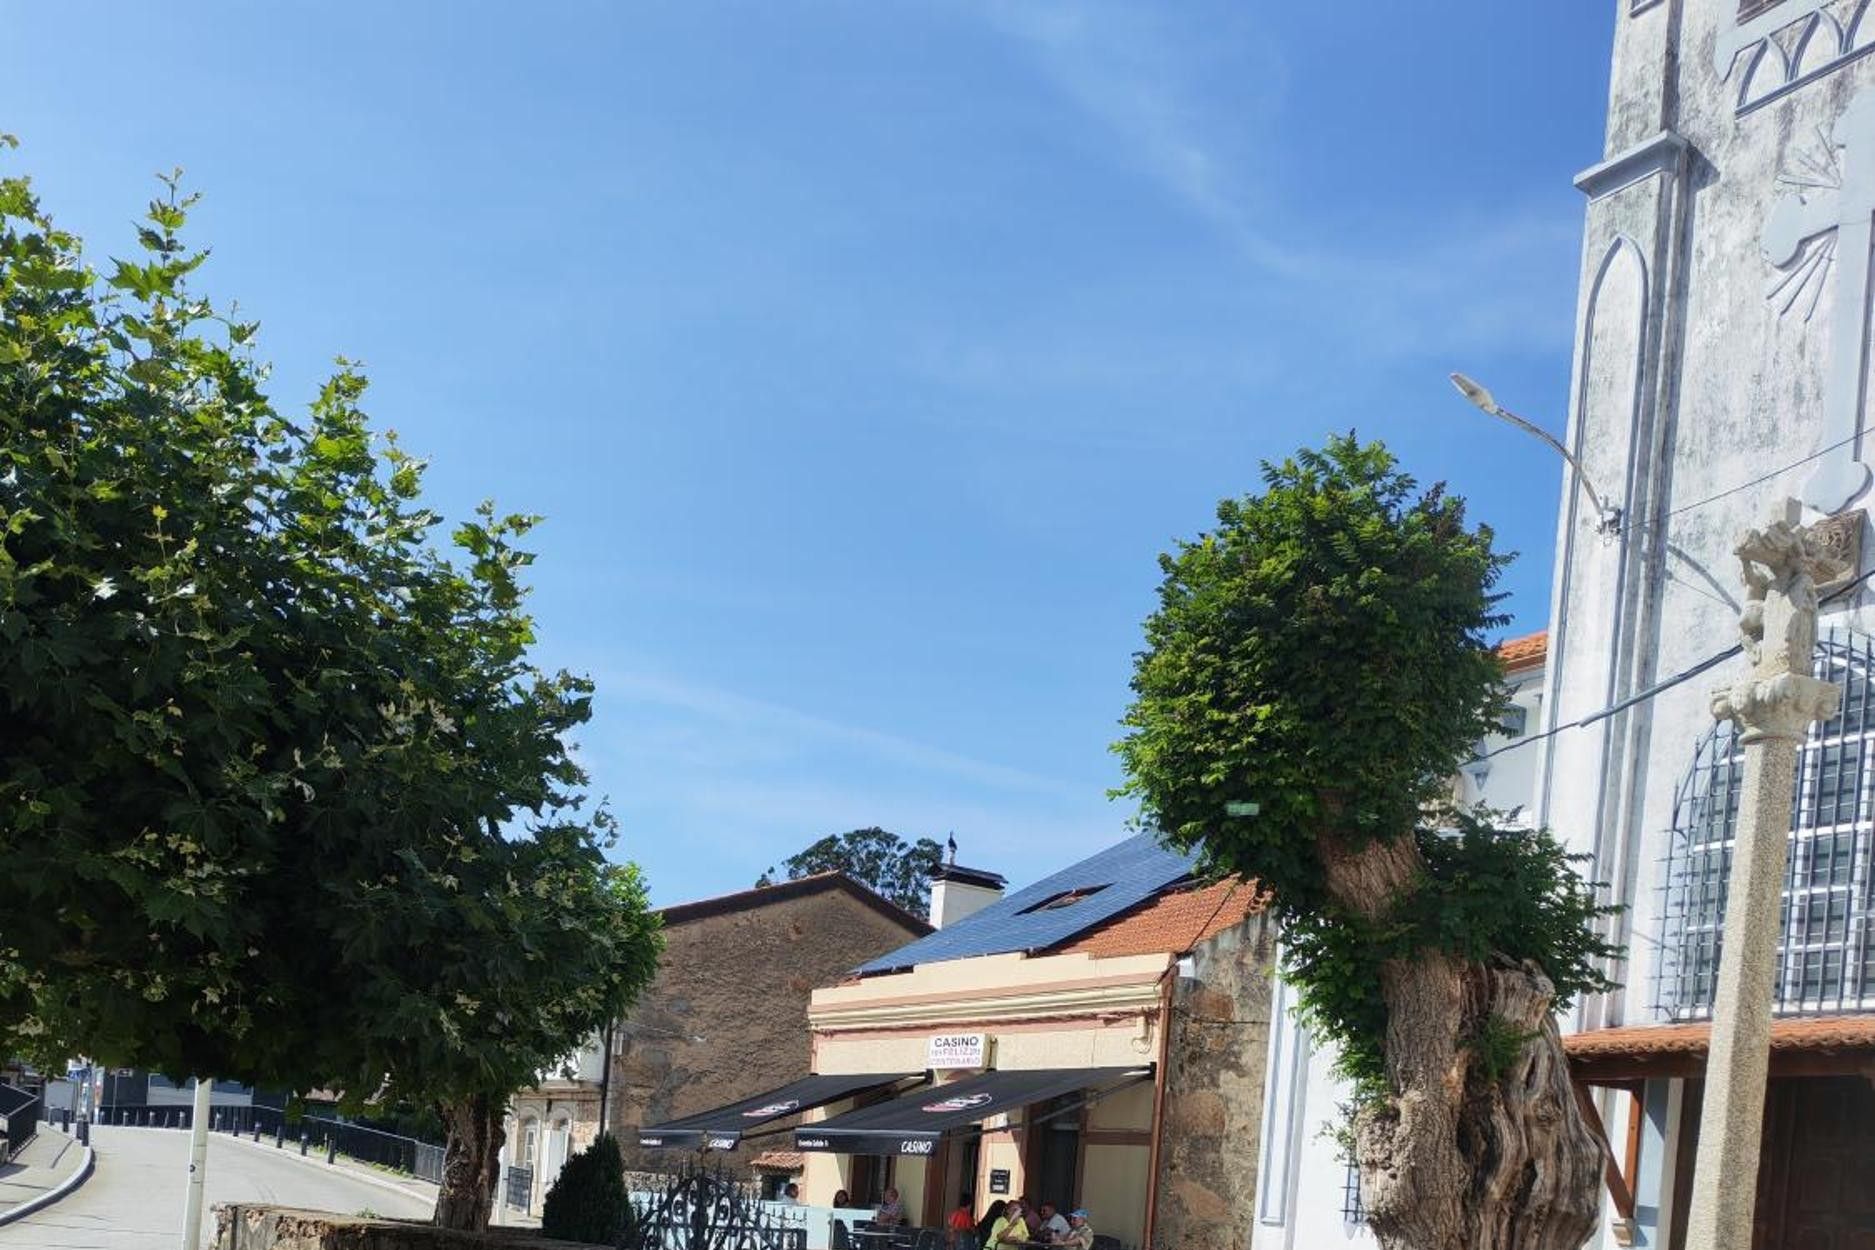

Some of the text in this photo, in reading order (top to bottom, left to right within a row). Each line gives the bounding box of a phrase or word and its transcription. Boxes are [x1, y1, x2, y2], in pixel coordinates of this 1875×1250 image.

[935, 1036, 979, 1047] CASINO
[707, 1138, 734, 1150] CASINO
[900, 1140, 932, 1153] CASINO
